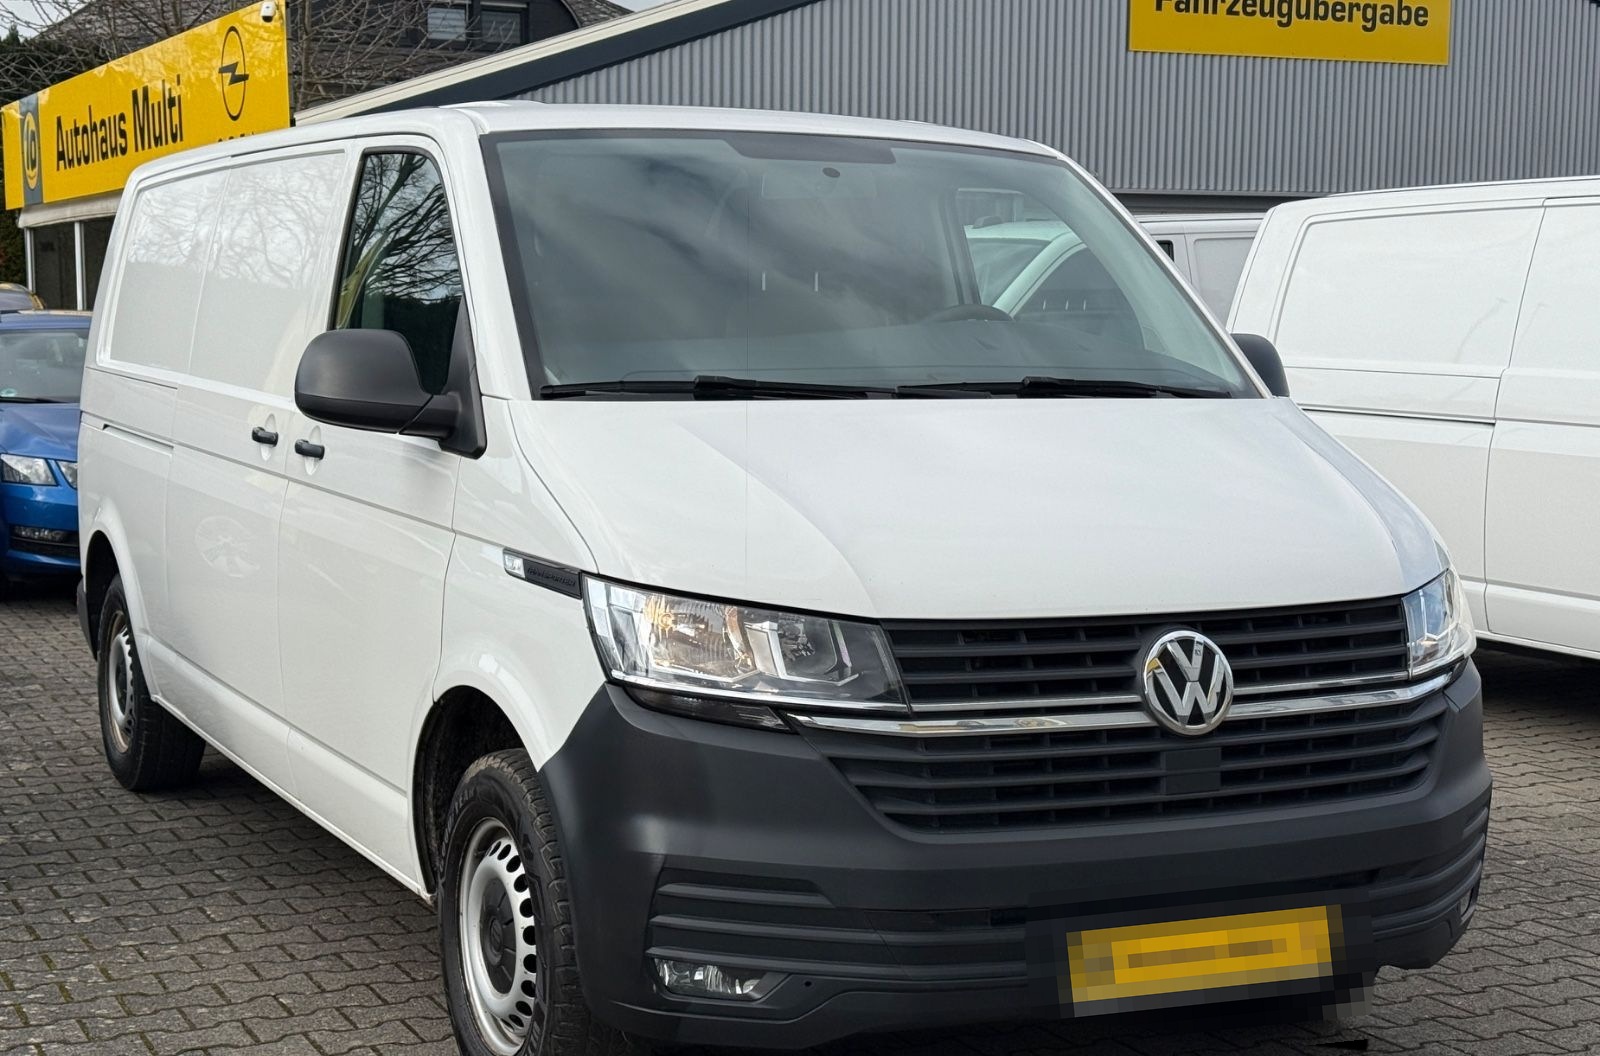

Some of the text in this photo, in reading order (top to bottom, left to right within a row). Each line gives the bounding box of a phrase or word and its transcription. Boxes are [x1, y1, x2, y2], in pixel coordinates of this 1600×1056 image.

[56, 74, 184, 172] Autohaus Multi
[1146, 635, 1228, 728] VW
